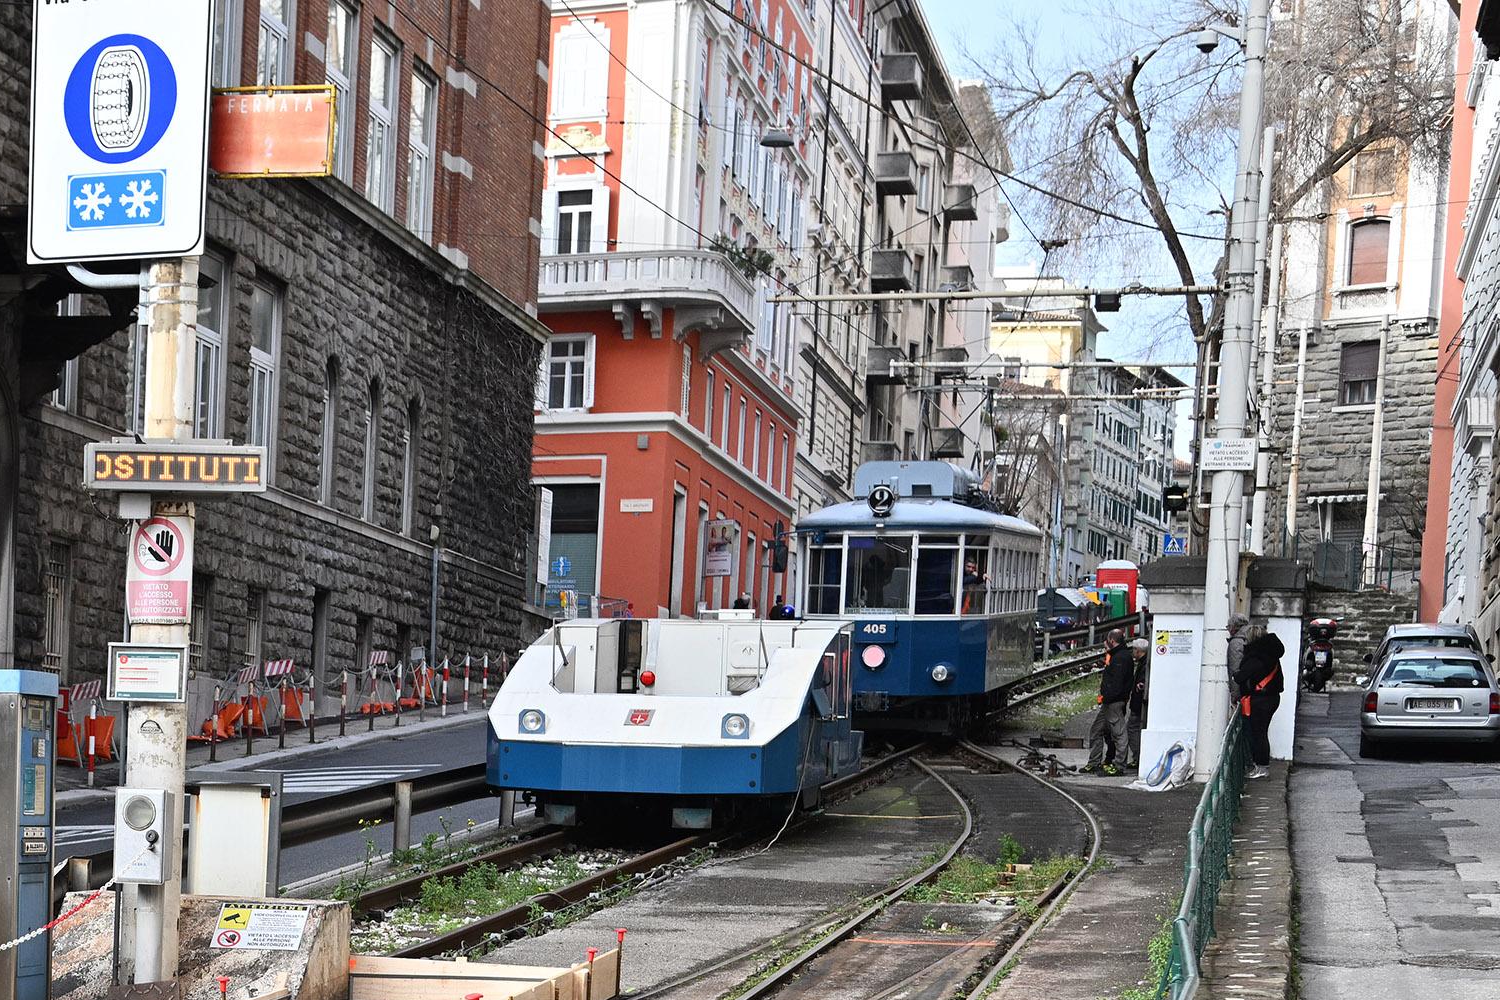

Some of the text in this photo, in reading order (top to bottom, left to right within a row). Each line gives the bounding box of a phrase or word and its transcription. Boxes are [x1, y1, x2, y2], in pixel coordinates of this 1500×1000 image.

[228, 97, 313, 114] FERMATA
[874, 490, 889, 510] 2
[863, 624, 887, 634] 405
